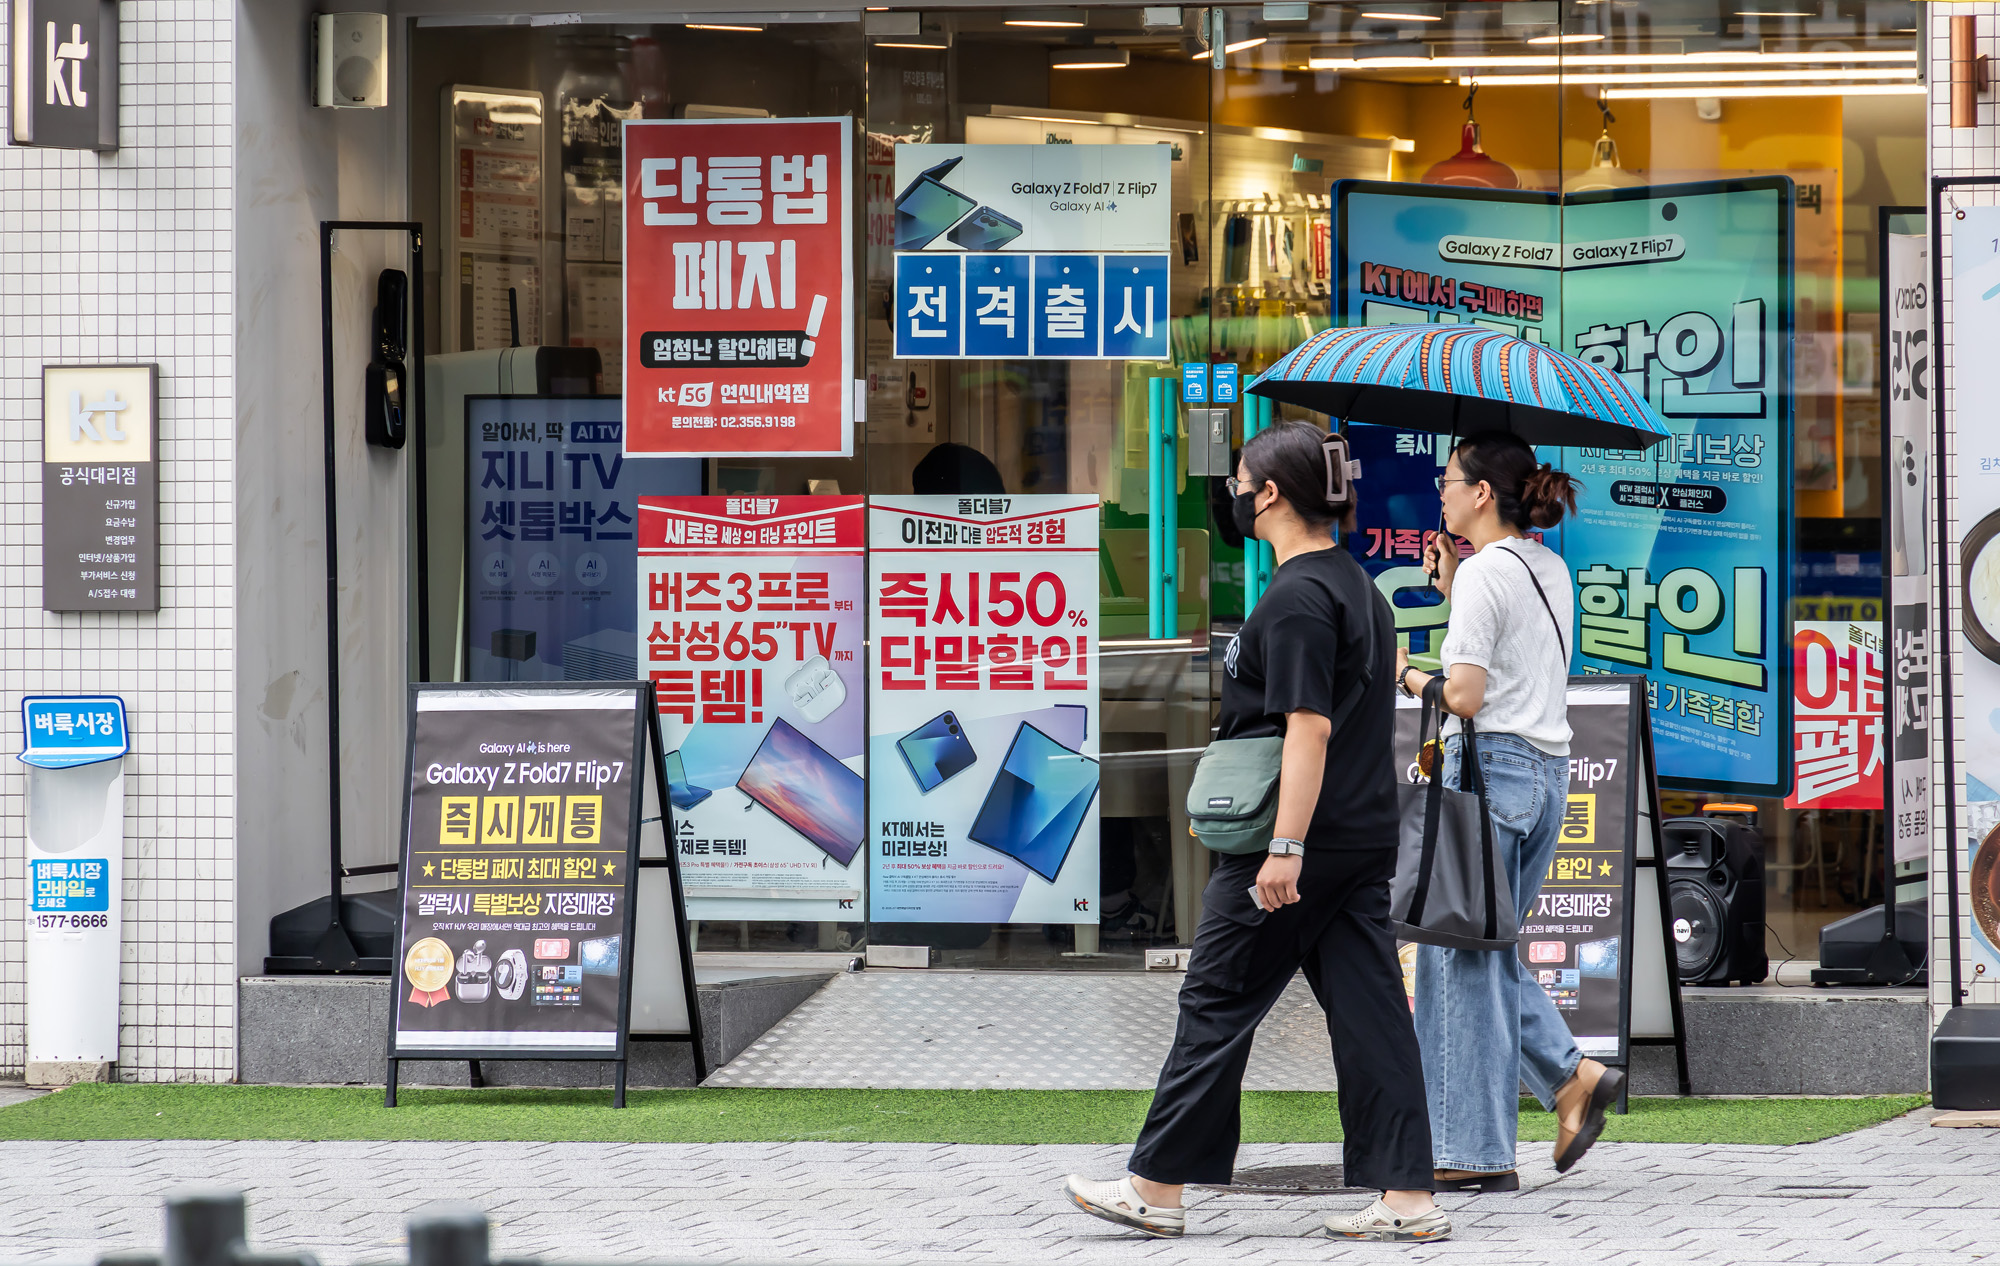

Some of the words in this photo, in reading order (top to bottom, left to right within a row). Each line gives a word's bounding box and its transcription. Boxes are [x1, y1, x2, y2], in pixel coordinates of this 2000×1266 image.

[46, 21, 89, 107] kt
[641, 154, 828, 226] 단통법
[1011, 181, 1063, 198] Galaxy
[1063, 182, 1072, 195] Z
[1073, 181, 1110, 195] Fold7
[1117, 182, 1126, 195] Z
[1128, 181, 1157, 198] Flip7
[1050, 201, 1092, 214] Galaxy
[1093, 201, 1105, 212] AI
[1445, 240, 1501, 260] Galaxy
[1502, 244, 1512, 257] Z
[1514, 245, 1554, 261] Fold7
[1572, 244, 1628, 263] Galaxy
[1629, 242, 1639, 255] Z
[1641, 238, 1674, 258] Flip7
[672, 239, 797, 310] 폐지
[1361, 262, 1457, 308] KT에서
[1459, 281, 1544, 321] 구매하면
[653, 338, 712, 361] 엄청난
[717, 337, 797, 360] 할인혜택
[658, 386, 676, 403] kt
[685, 389, 707, 402] 5G
[720, 383, 810, 404] 연신내역점
[69, 389, 127, 441] kt
[671, 416, 718, 429] 문의전화:
[721, 416, 796, 429] 02.356.9198
[482, 421, 543, 443] 알아서,
[545, 421, 564, 442] 딱
[576, 425, 594, 439] AI
[597, 425, 621, 439] TV
[1395, 433, 1433, 456] 즉시
[60, 466, 136, 485] 공식대리점
[481, 451, 554, 490] 지니
[563, 453, 624, 490] TV
[1581, 464, 1596, 473] 2년
[1598, 465, 1607, 474] 후
[1609, 466, 1626, 475] 최대
[1628, 467, 1652, 477] 50%
[1674, 469, 1700, 480] 혜택을
[1702, 471, 1720, 481] 지금
[1722, 471, 1740, 482] 바로
[1742, 472, 1763, 483] 할인!
[1619, 484, 1632, 493] NEW
[1634, 485, 1655, 495] 갤럭시
[1671, 488, 1712, 500] 안심체인지
[105, 500, 136, 510] 신규가입
[725, 498, 779, 515] 폴더블7
[957, 498, 1012, 515] 폴더블7
[1679, 499, 1704, 510] 플러스
[105, 517, 136, 527] 요금수납
[480, 501, 632, 542] 셋톱박스
[664, 518, 718, 545] 새로운
[760, 526, 780, 544] 터닝
[783, 517, 836, 544] 포인트
[902, 517, 958, 545] 이전과
[961, 526, 982, 545] 다른
[986, 524, 1022, 545] 압도적
[1027, 518, 1066, 545] 경험
[105, 535, 136, 545] 변경업무
[1365, 528, 1441, 560] 가족
[78, 553, 136, 563] 인터넷/상품가입
[493, 559, 504, 569] AI
[538, 559, 550, 569] AI
[586, 559, 597, 569] AI
[80, 571, 118, 581] 부가서비스
[120, 571, 136, 581] 신청
[88, 588, 118, 598] A/S접수
[120, 588, 136, 598] 대행
[1577, 565, 1768, 693] 할인
[880, 633, 1088, 691] 단말할인
[649, 668, 763, 724] 득템!
[1664, 683, 1764, 737] 가족결합
[34, 712, 115, 735] 벼룩시장
[479, 743, 514, 756] Galaxy
[516, 742, 526, 753] AI
[538, 742, 546, 753] is
[547, 742, 570, 753] here
[426, 762, 500, 791] Galaxy
[503, 762, 516, 784] Z
[519, 762, 572, 784] Fold7
[575, 760, 624, 790] Flip7
[882, 821, 945, 838] KT에서는
[675, 839, 709, 855] 제로
[713, 839, 746, 855] 득템!
[882, 841, 948, 857] 미리보상!
[37, 862, 102, 880] 벼룩시장
[440, 858, 489, 879] 단통법
[491, 858, 524, 879] 폐지
[527, 857, 561, 879] 최대
[563, 857, 598, 878] 할인
[1556, 857, 1593, 880] 할인
[37, 880, 96, 898] 모바일로
[37, 898, 66, 908] 보세요
[418, 893, 470, 916] 갤럭시
[473, 893, 542, 916] 특별보상
[544, 893, 615, 916] 지정매장
[1074, 898, 1089, 911] kt
[1537, 893, 1612, 918] 지정매장
[36, 914, 108, 928] 1577-6666
[432, 922, 445, 931] 오직
[467, 922, 480, 931] 우리
